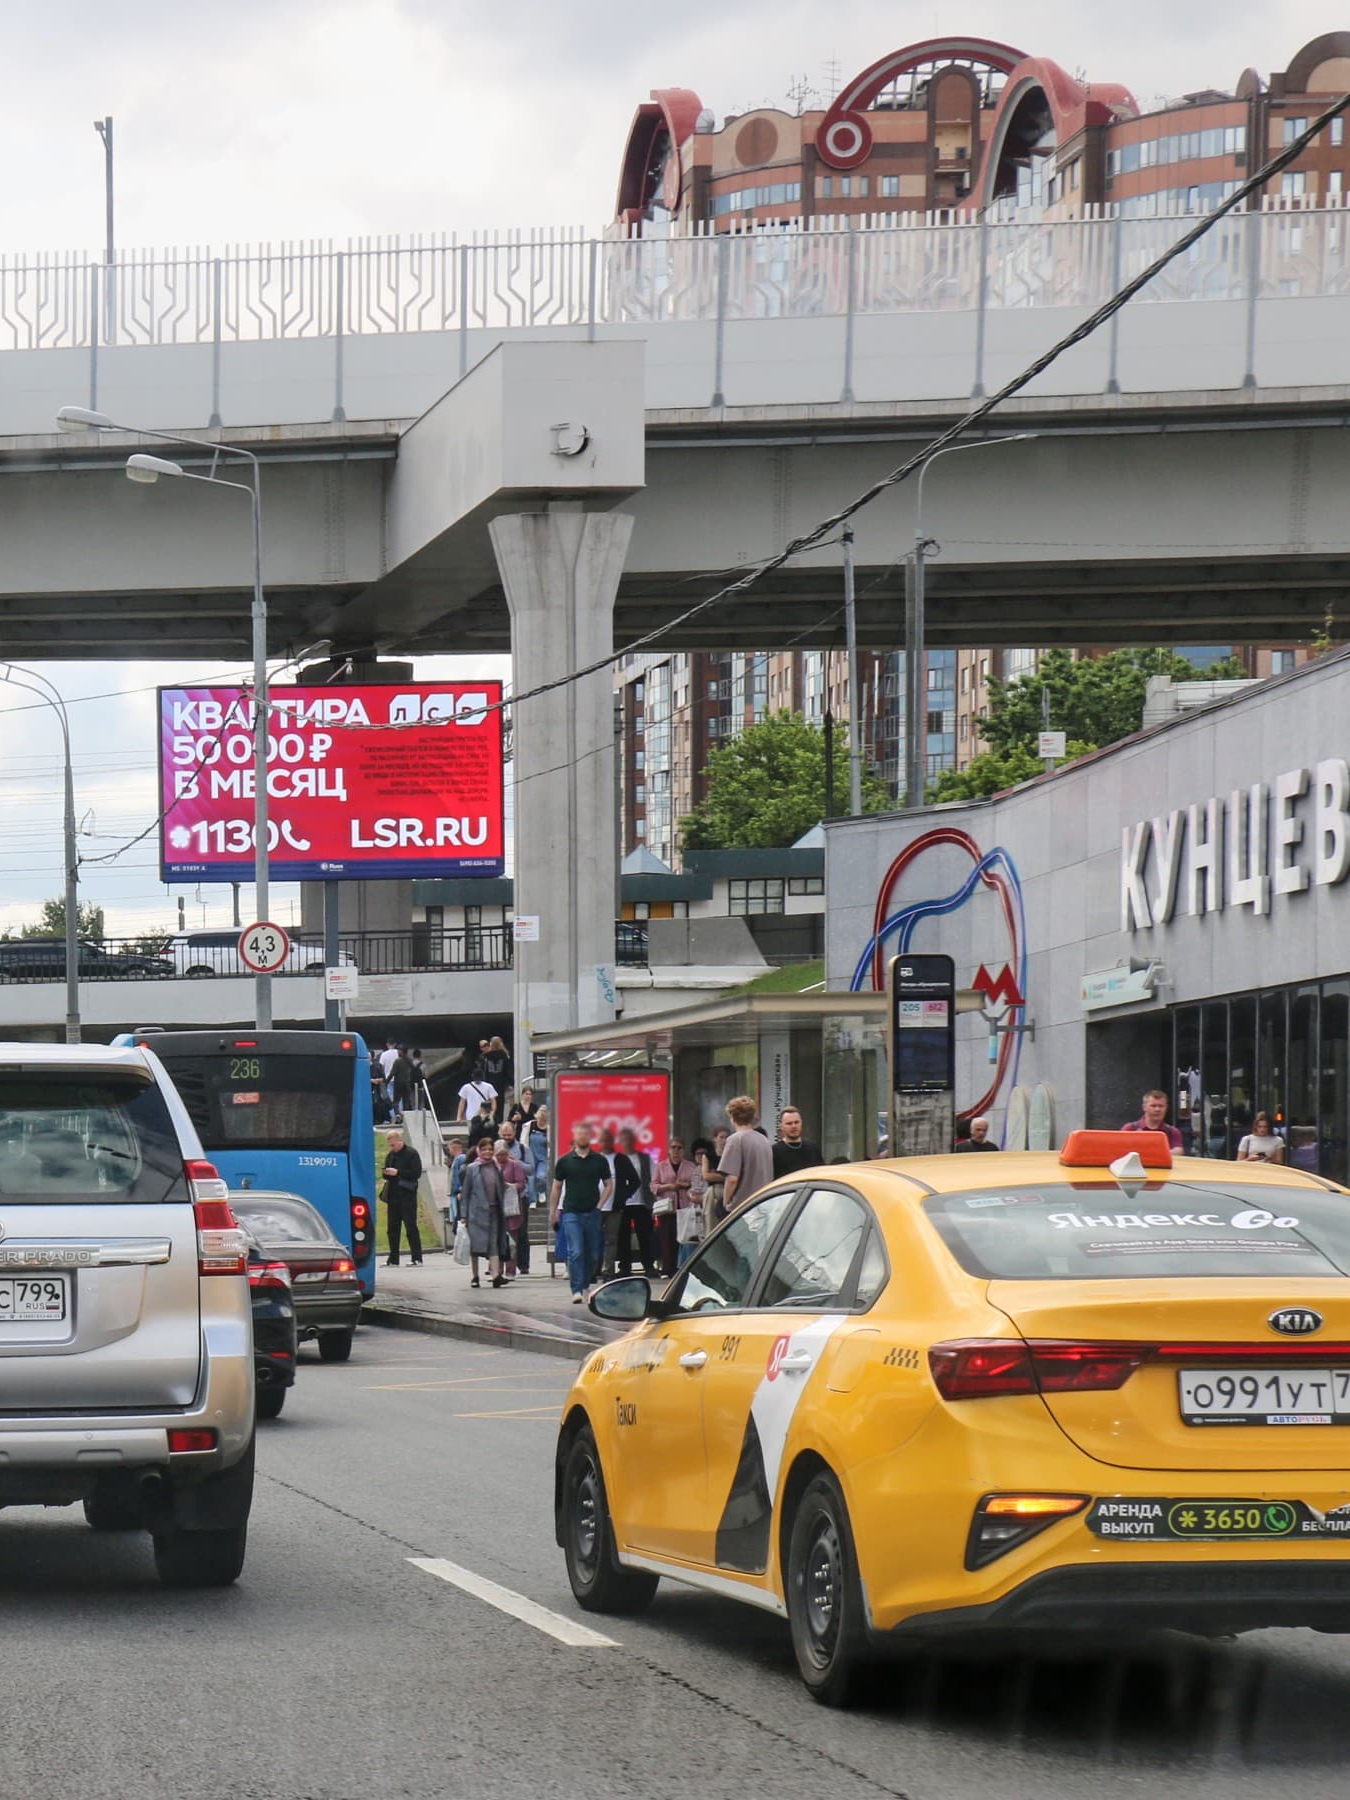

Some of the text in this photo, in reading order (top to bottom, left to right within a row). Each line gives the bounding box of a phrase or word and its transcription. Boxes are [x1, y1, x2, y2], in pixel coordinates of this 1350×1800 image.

[175, 770, 199, 800] В
[211, 768, 347, 801] МЕСЯЦ
[351, 816, 488, 848] LSR.RU
[249, 936, 276, 955] 4,3
[258, 956, 268, 965] М
[230, 1058, 260, 1079] 236
[298, 1156, 338, 1166] 1319091
[1049, 1209, 1299, 1229] Яндекс Go
[25, 1250, 91, 1263] PRADO
[17, 1282, 56, 1302] 799
[25, 1302, 45, 1310] RUS
[1279, 1314, 1315, 1330] KIA
[719, 1336, 742, 1361] 991
[616, 1396, 637, 1426] Такси
[1098, 1504, 1163, 1518] АРЕНДА
[1101, 1522, 1155, 1534] ВЫКУП
